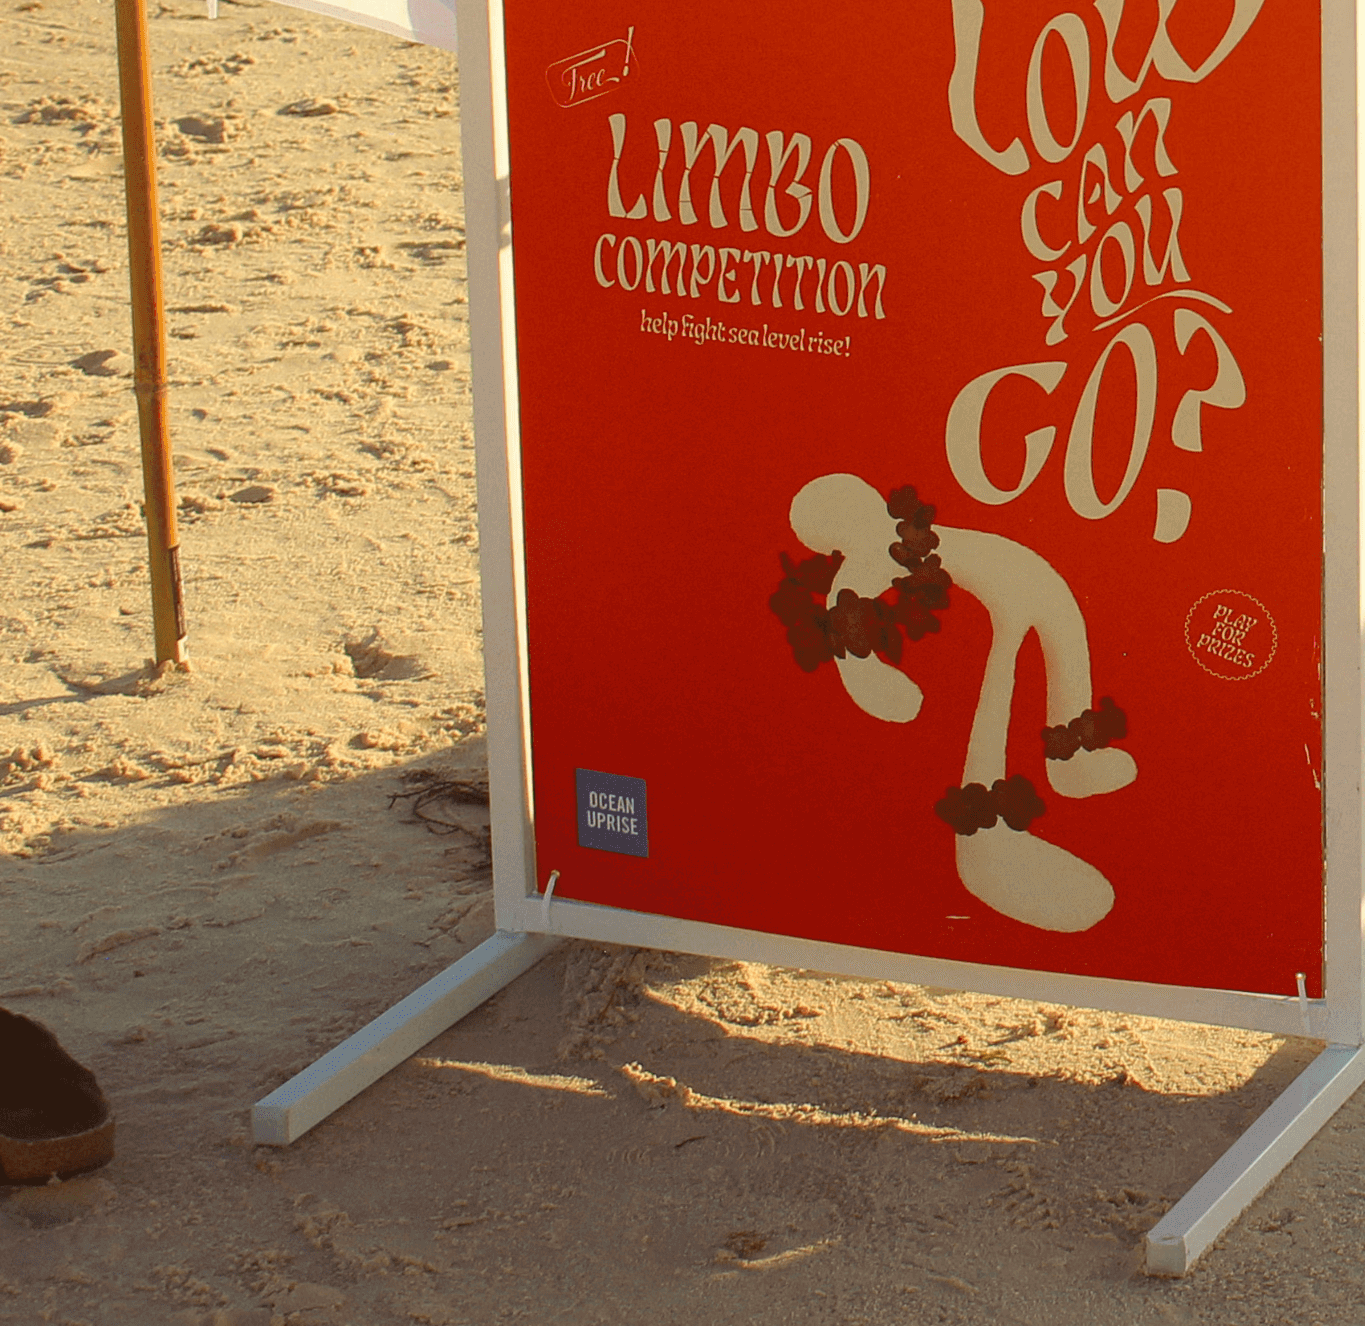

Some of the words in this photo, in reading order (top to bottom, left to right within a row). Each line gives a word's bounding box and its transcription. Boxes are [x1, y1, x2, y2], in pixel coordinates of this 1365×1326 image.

[606, 113, 870, 244] LIMBO
[1020, 97, 1179, 262] CAN
[594, 234, 887, 319] COMPETITION
[1031, 187, 1192, 346] YOU
[640, 309, 679, 341] help
[682, 314, 726, 345] fight
[728, 327, 760, 346] sea
[762, 324, 805, 352] level
[808, 331, 851, 357] rise!
[945, 307, 1247, 544] GO?
[1211, 621, 1247, 647] FOR
[1213, 604, 1258, 632] PLAY
[1196, 633, 1256, 668] PRIZES
[586, 810, 639, 836] UPRISE
[589, 790, 635, 815] OCEAN
